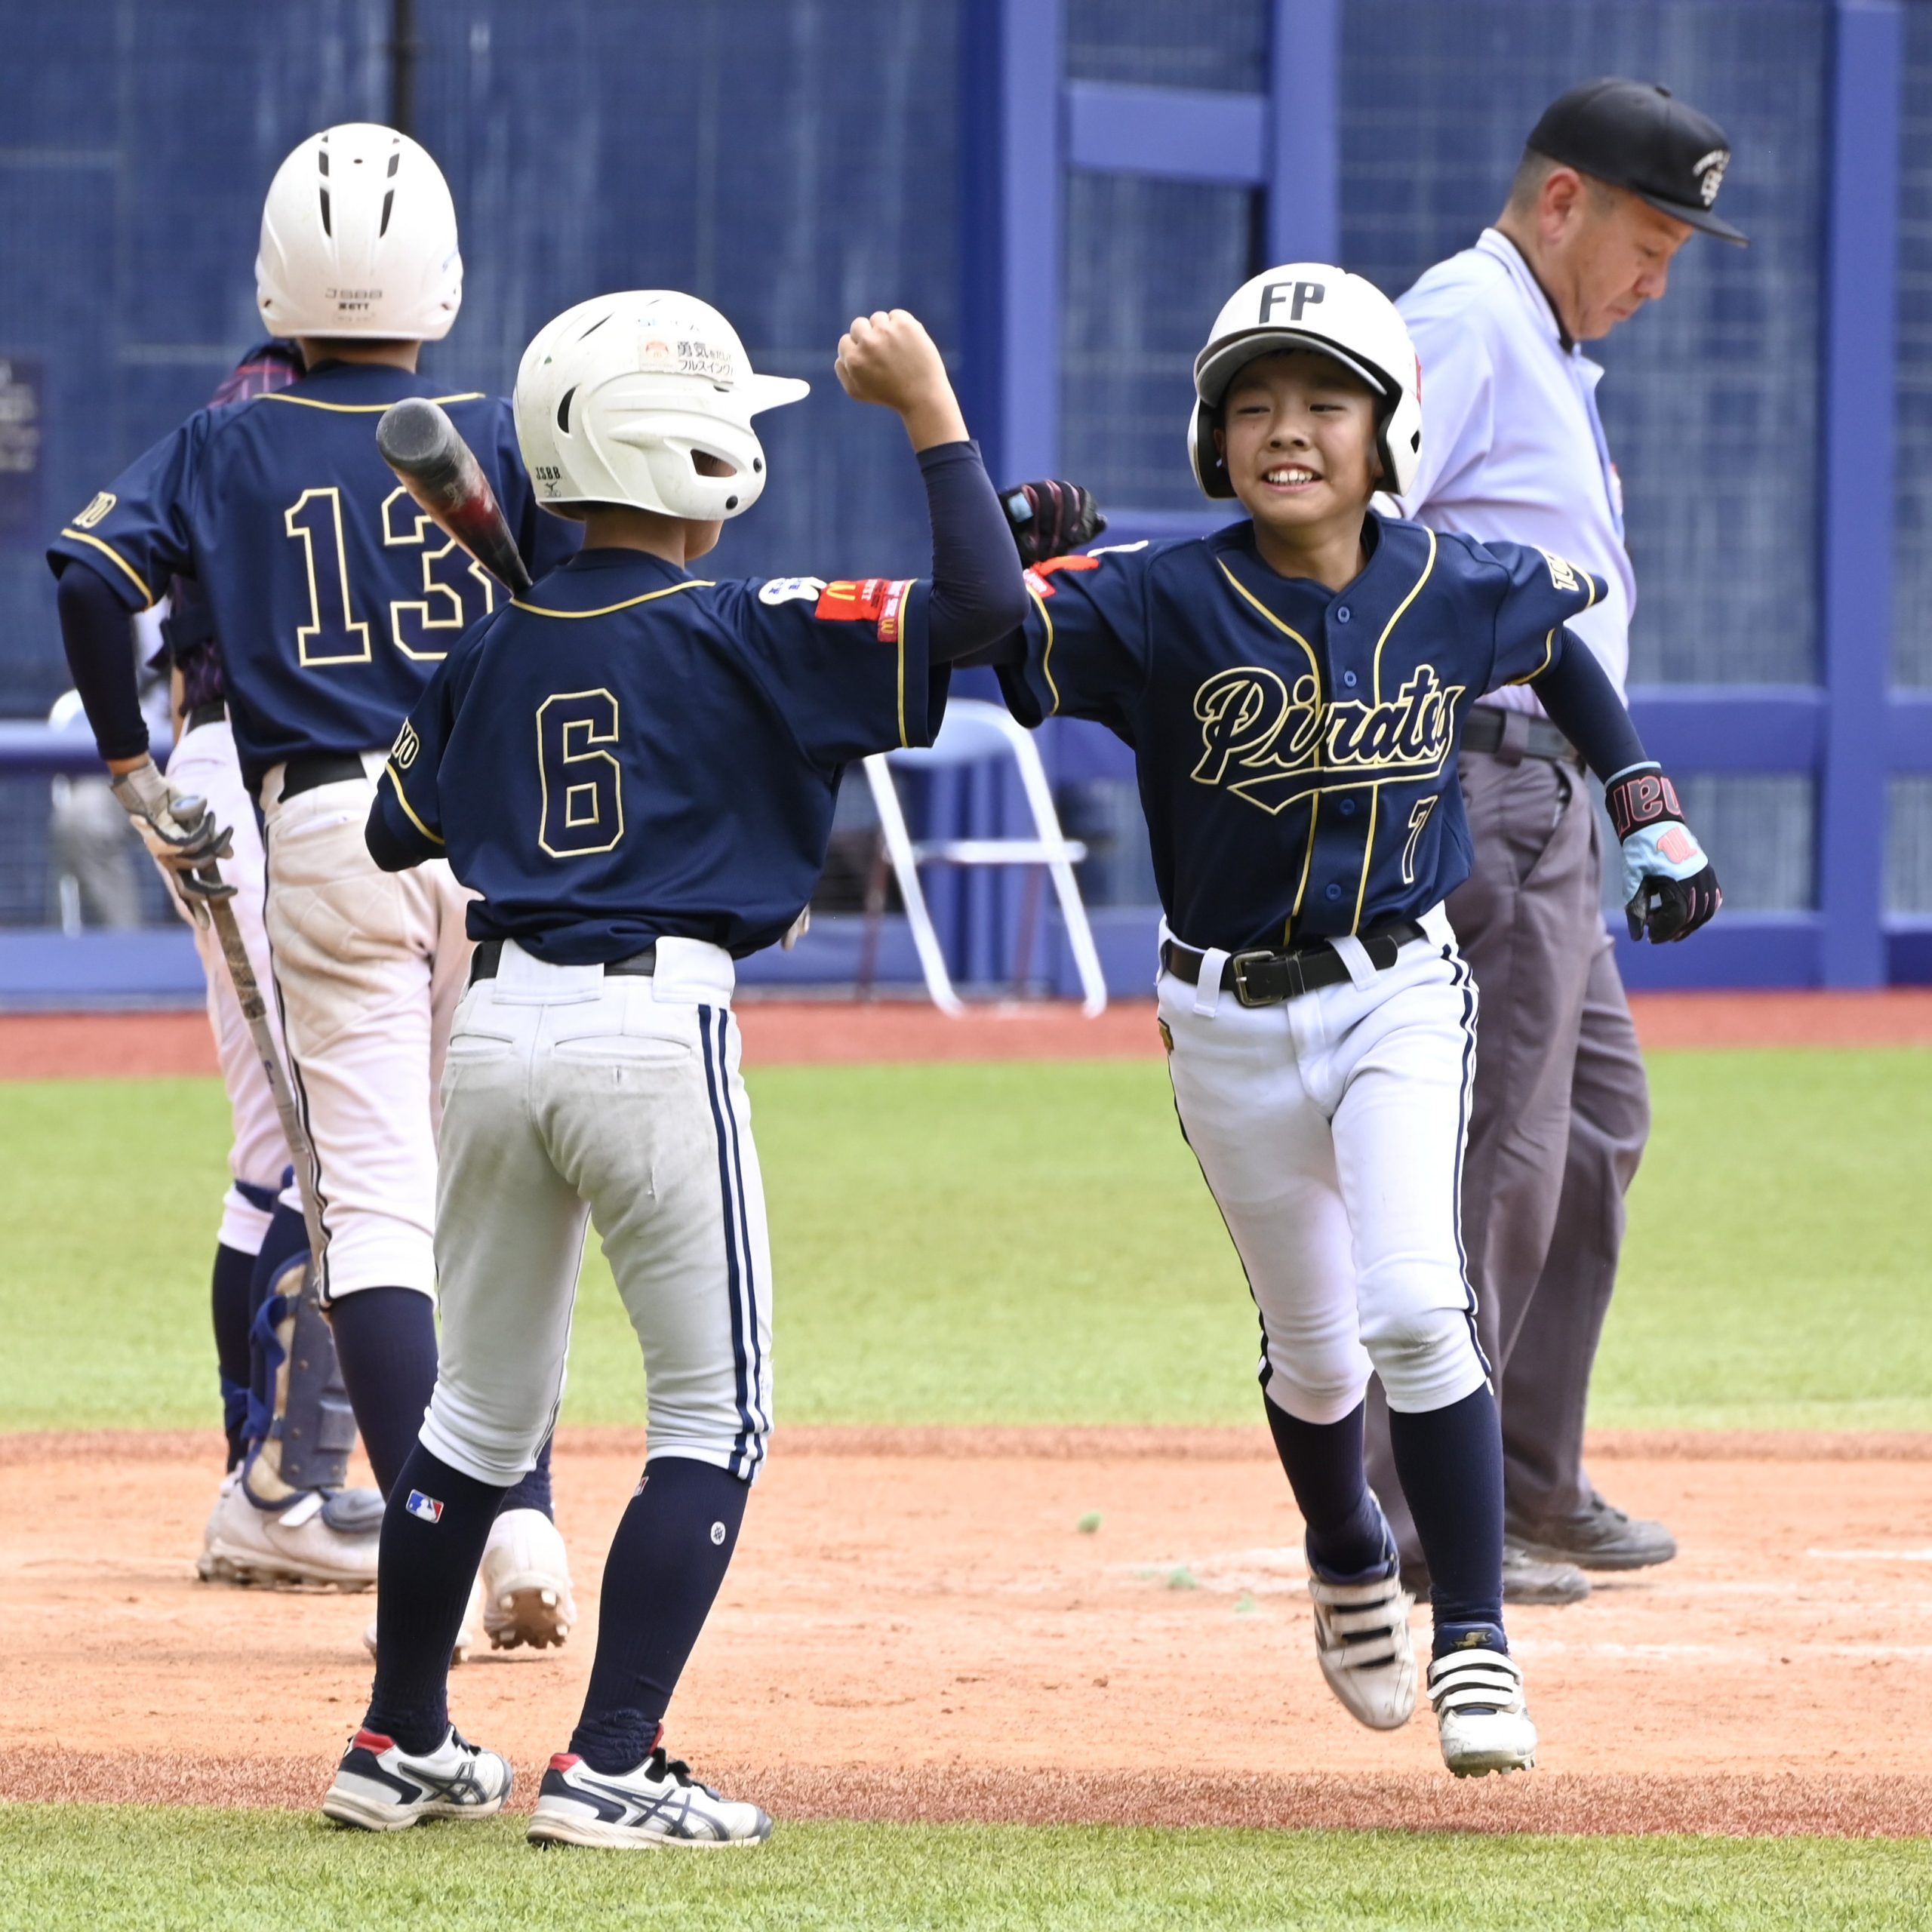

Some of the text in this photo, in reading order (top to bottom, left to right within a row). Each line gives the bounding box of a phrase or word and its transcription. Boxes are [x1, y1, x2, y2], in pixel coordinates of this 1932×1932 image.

[1259, 281, 1326, 325] FP
[285, 486, 494, 666] 13
[537, 688, 624, 858] 6
[1401, 795, 1438, 884] 7
